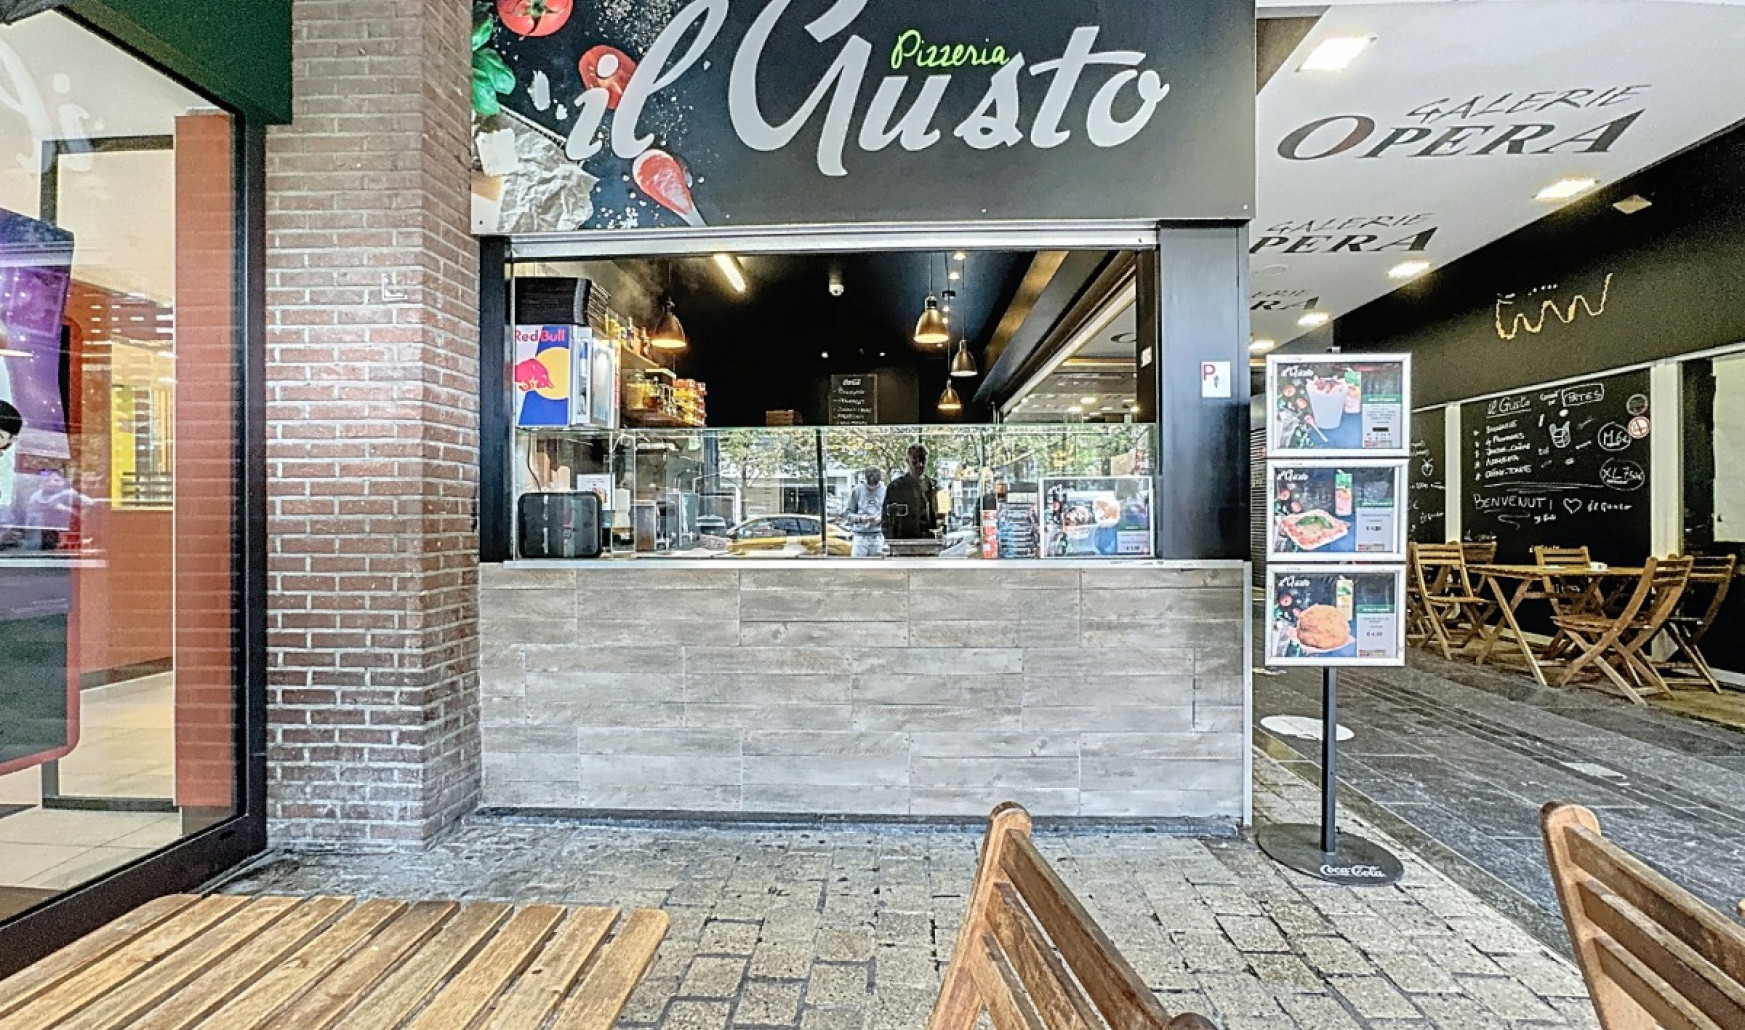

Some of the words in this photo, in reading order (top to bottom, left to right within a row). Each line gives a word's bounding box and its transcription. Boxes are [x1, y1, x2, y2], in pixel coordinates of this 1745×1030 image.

[891, 29, 1010, 71] Pizzeria
[563, 0, 728, 161] il
[728, 0, 1171, 177] Gusto
[1405, 83, 1653, 124] GALERIE
[1276, 108, 1647, 161] OPERA
[1248, 226, 1439, 254] PERA
[1267, 212, 1437, 235] GALERIE
[515, 329, 539, 342] Red
[541, 329, 565, 342] Bull
[1203, 364, 1216, 381] P
